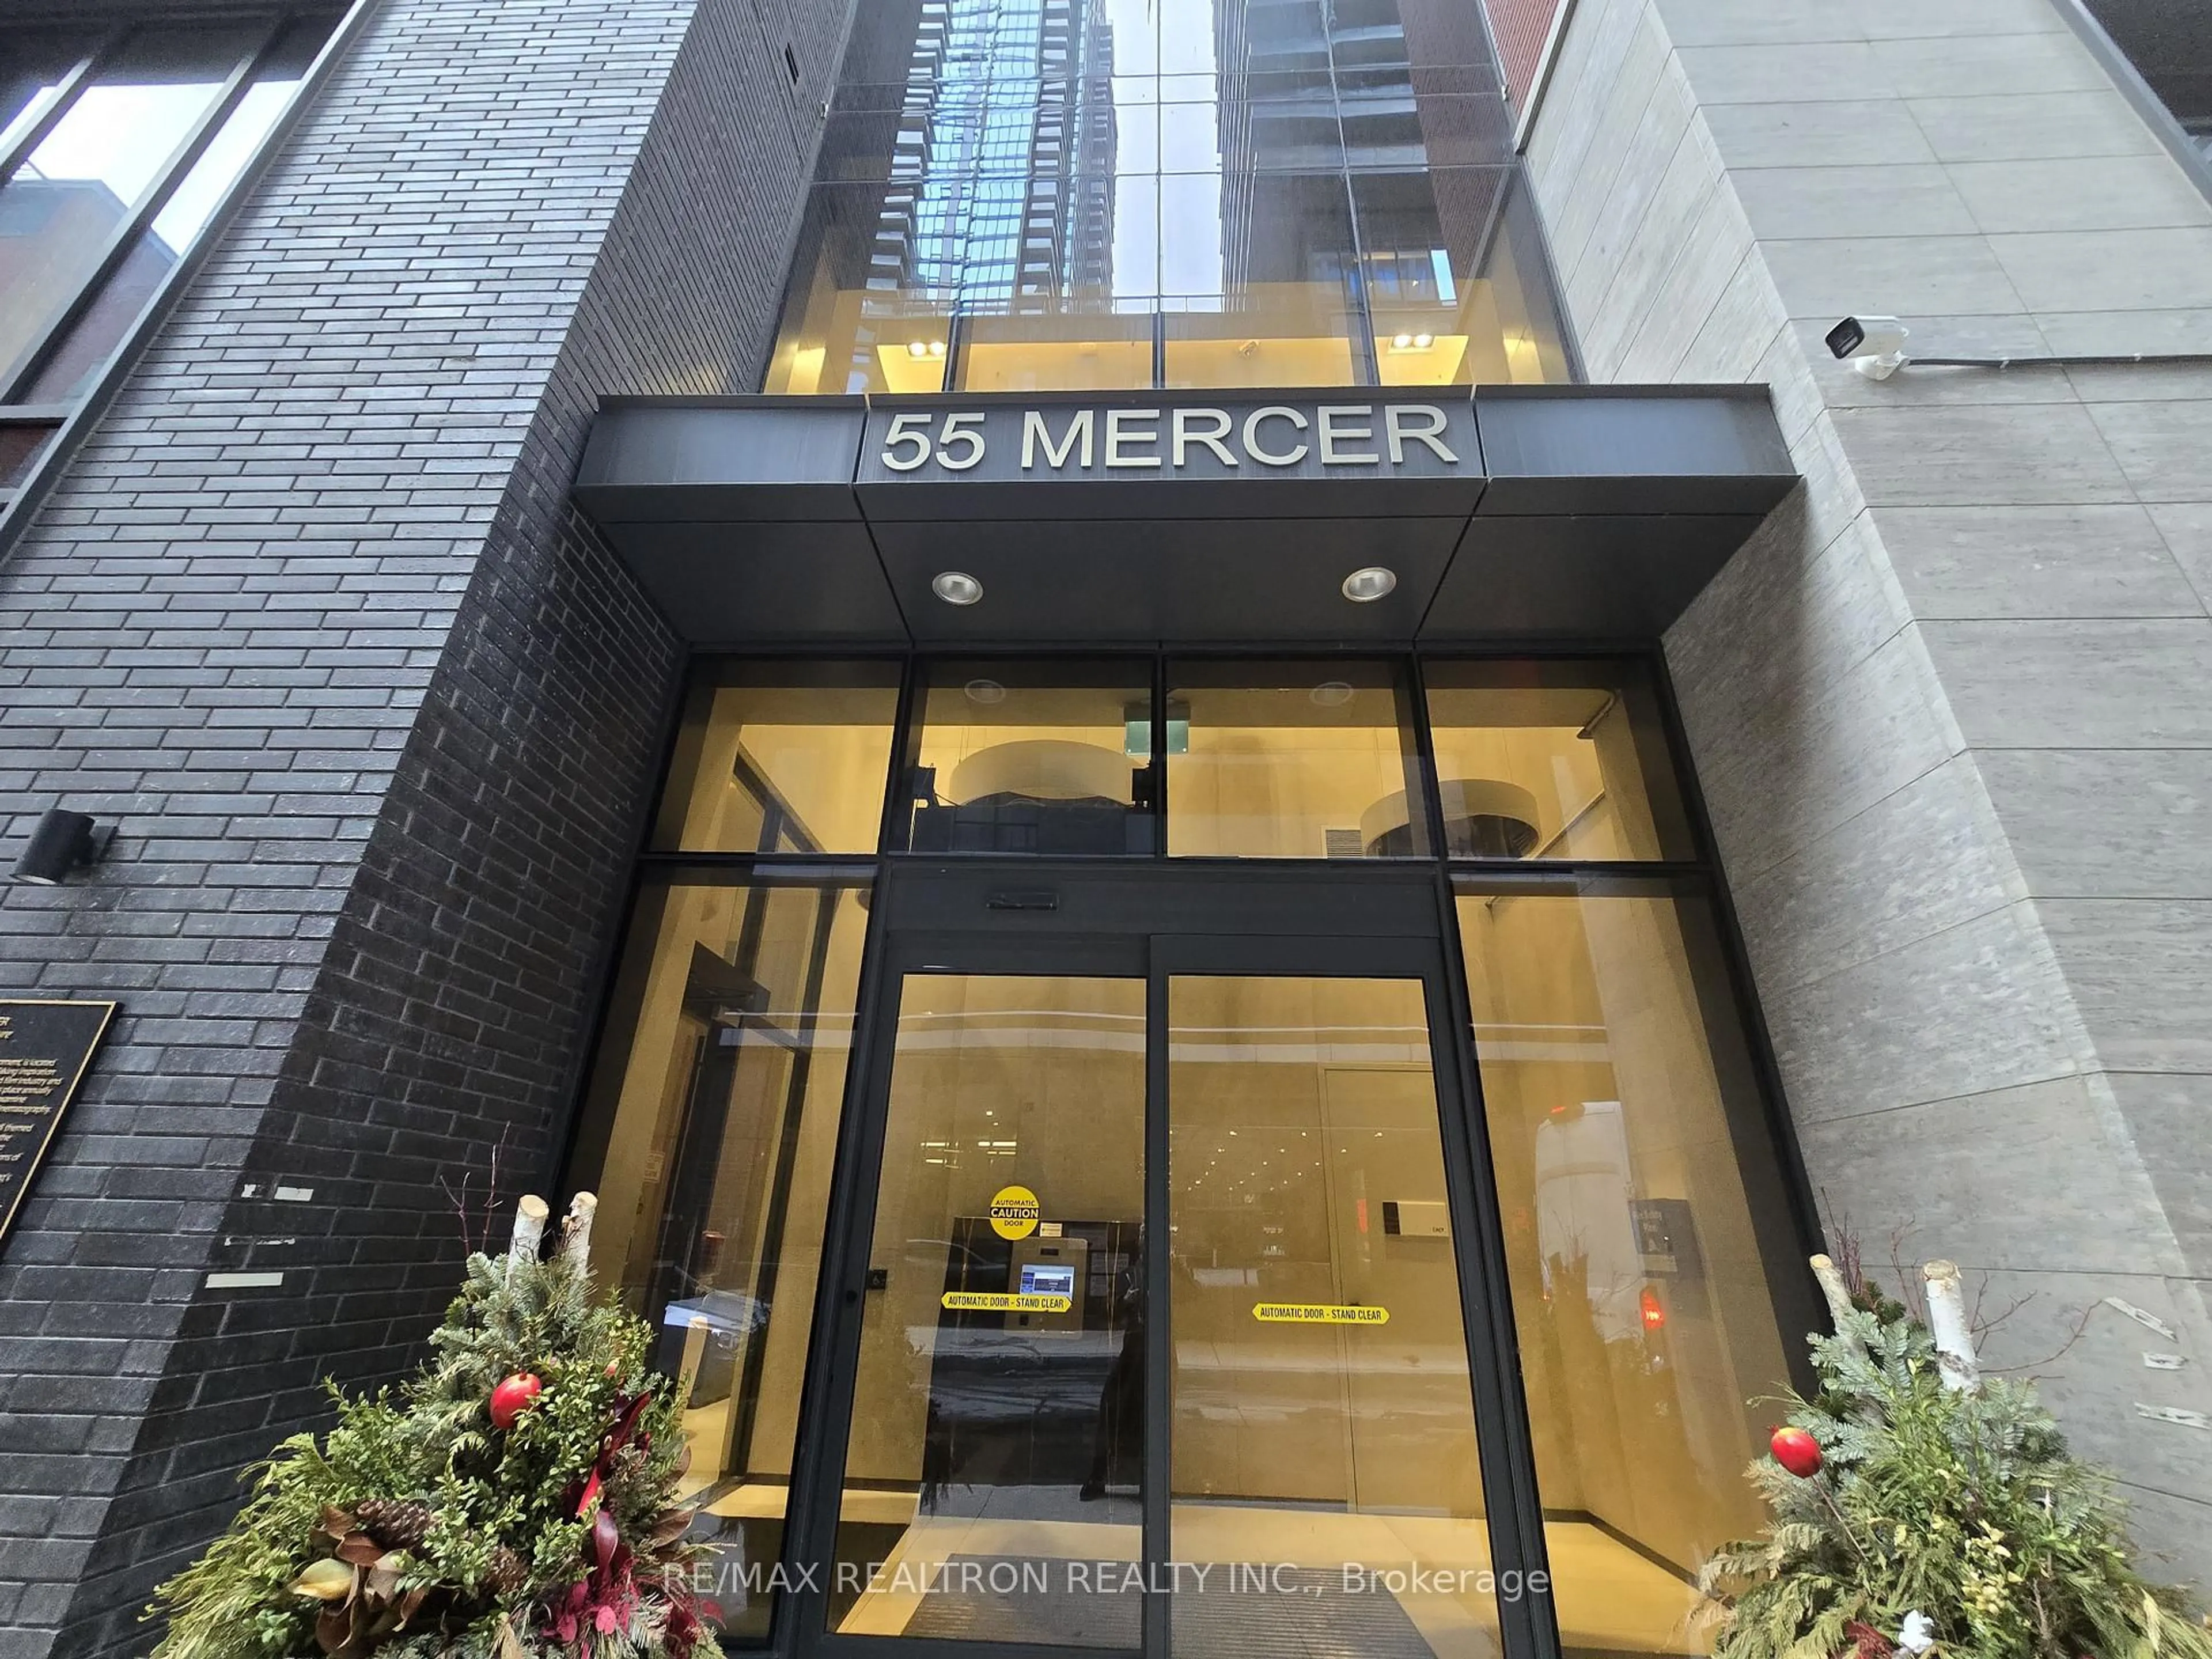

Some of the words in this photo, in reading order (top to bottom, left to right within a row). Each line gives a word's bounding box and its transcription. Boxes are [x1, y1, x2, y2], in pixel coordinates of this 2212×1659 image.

[881, 412, 985, 471] 55
[1020, 404, 1459, 468] MERCER
[991, 1208, 1039, 1218] CAUTION
[948, 1296, 988, 1305] AUTOMATIC
[990, 1297, 1009, 1306] DOOR
[1016, 1298, 1039, 1307] STAND
[1041, 1299, 1064, 1308] CLEAR
[1260, 1308, 1302, 1318] AUTOMATIC
[1304, 1309, 1324, 1318] DOOR
[1332, 1310, 1355, 1320] STAND
[1358, 1311, 1381, 1320] CLEAR
